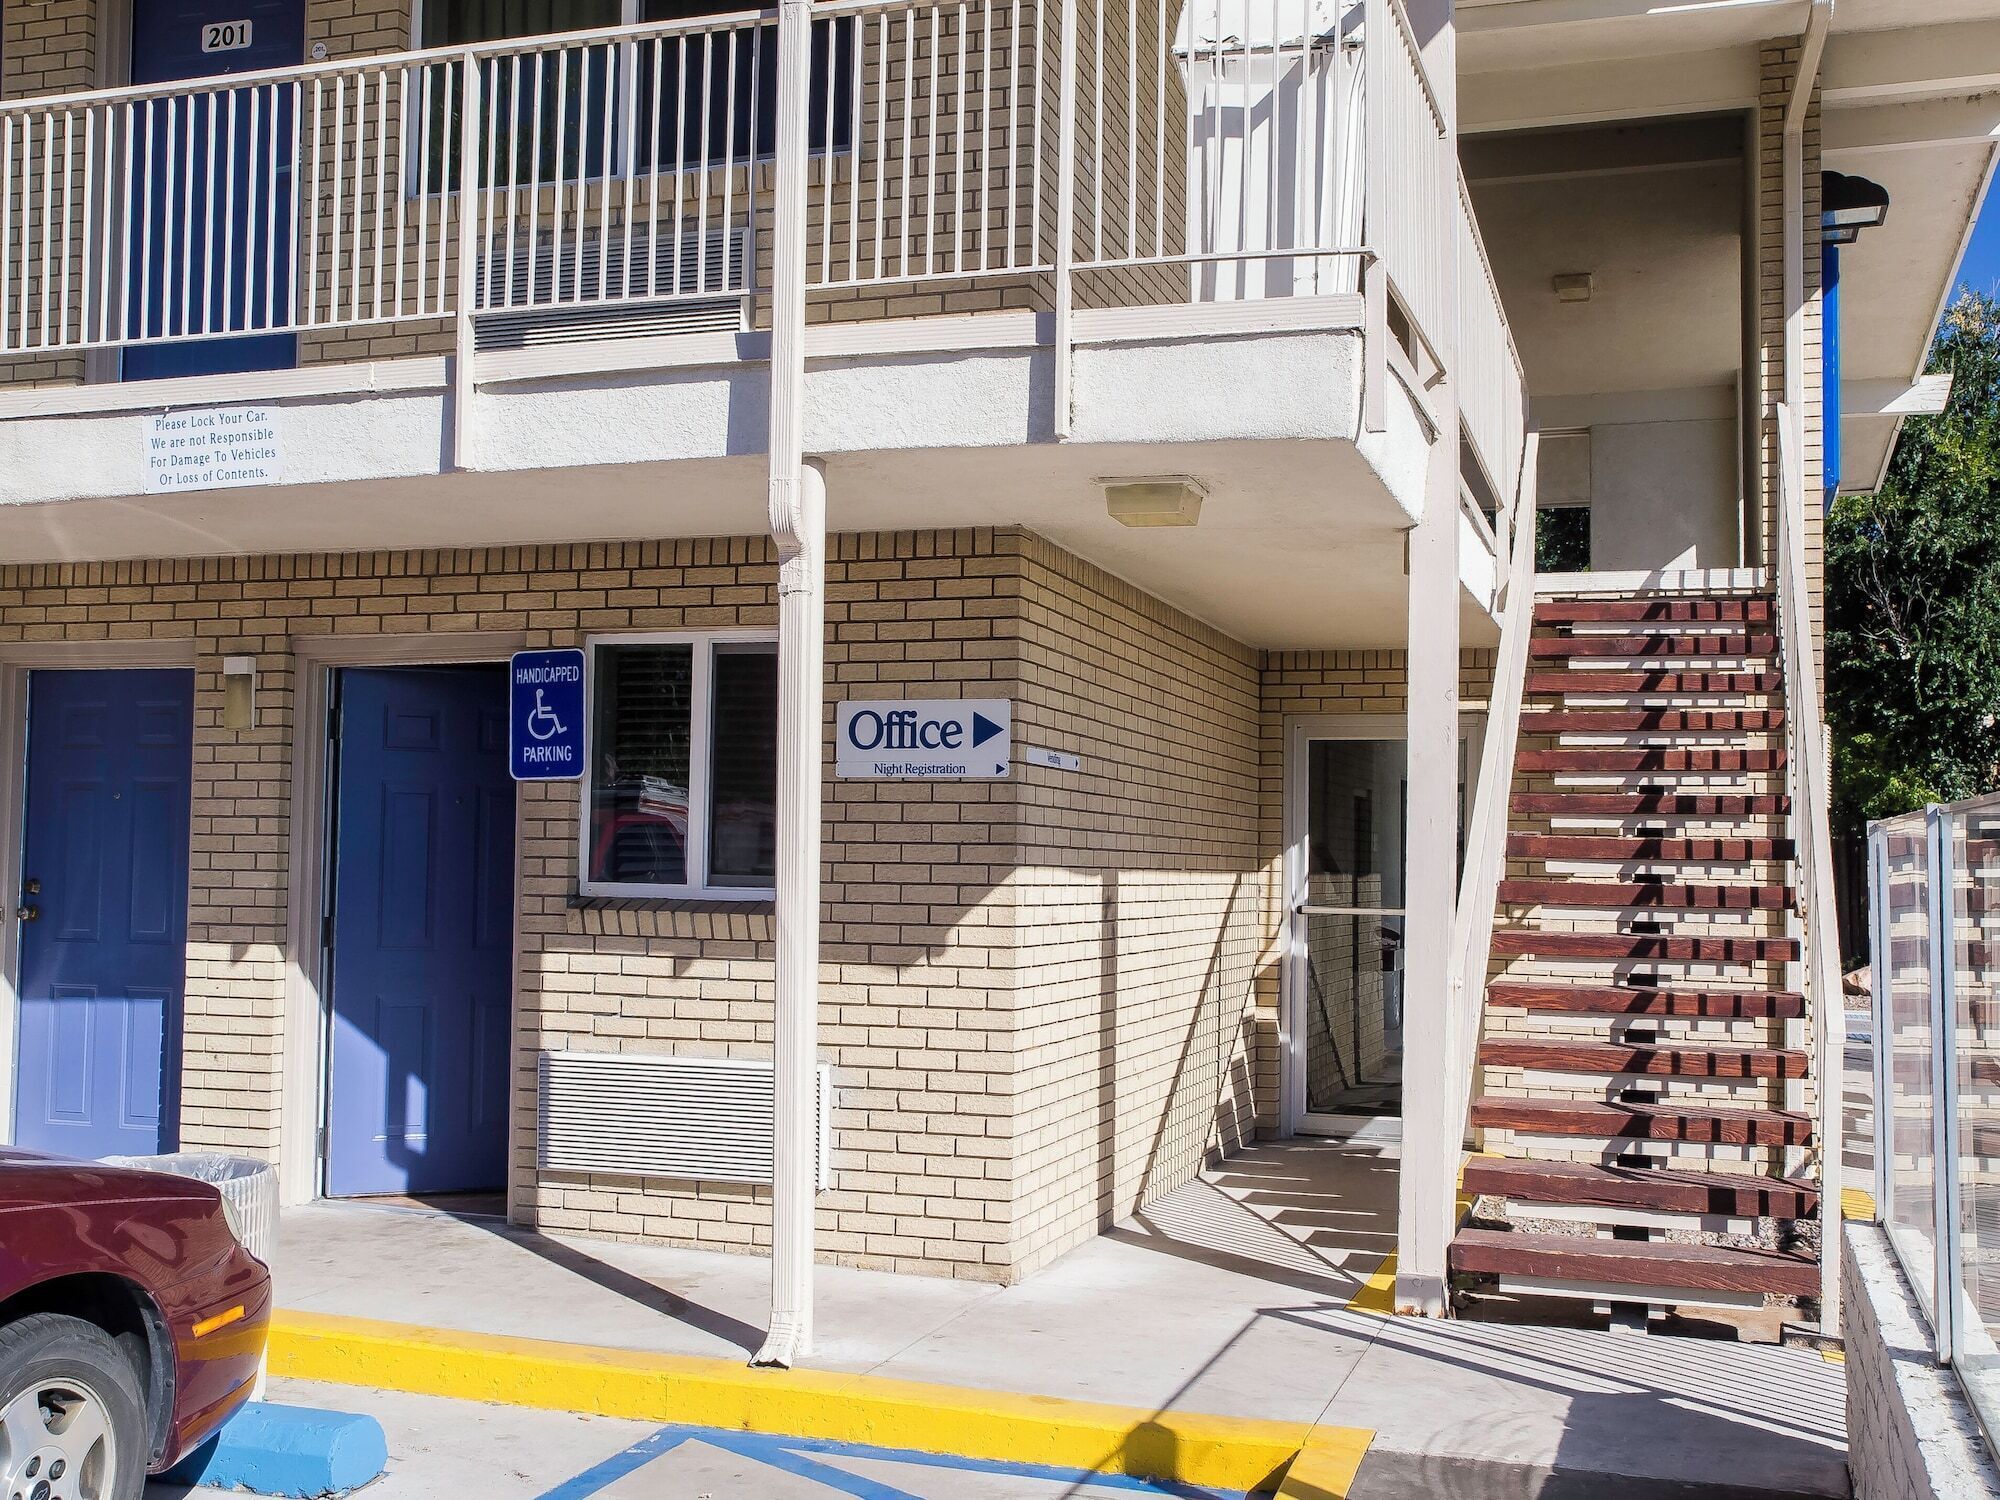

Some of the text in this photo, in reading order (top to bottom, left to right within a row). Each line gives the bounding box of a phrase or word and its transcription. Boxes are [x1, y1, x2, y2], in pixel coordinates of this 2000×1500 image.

[208, 24, 246, 48] 201
[155, 410, 268, 431] Please Lock Your Car.
[151, 429, 274, 449] We are not Responsible
[151, 448, 276, 468] For Damage To Vehicles
[160, 467, 268, 485] Or Loss of Contents.
[516, 666, 579, 684] HANDICAPPED
[848, 710, 963, 751] Office
[523, 745, 572, 763] PARKING
[874, 763, 967, 777] Night Registration
